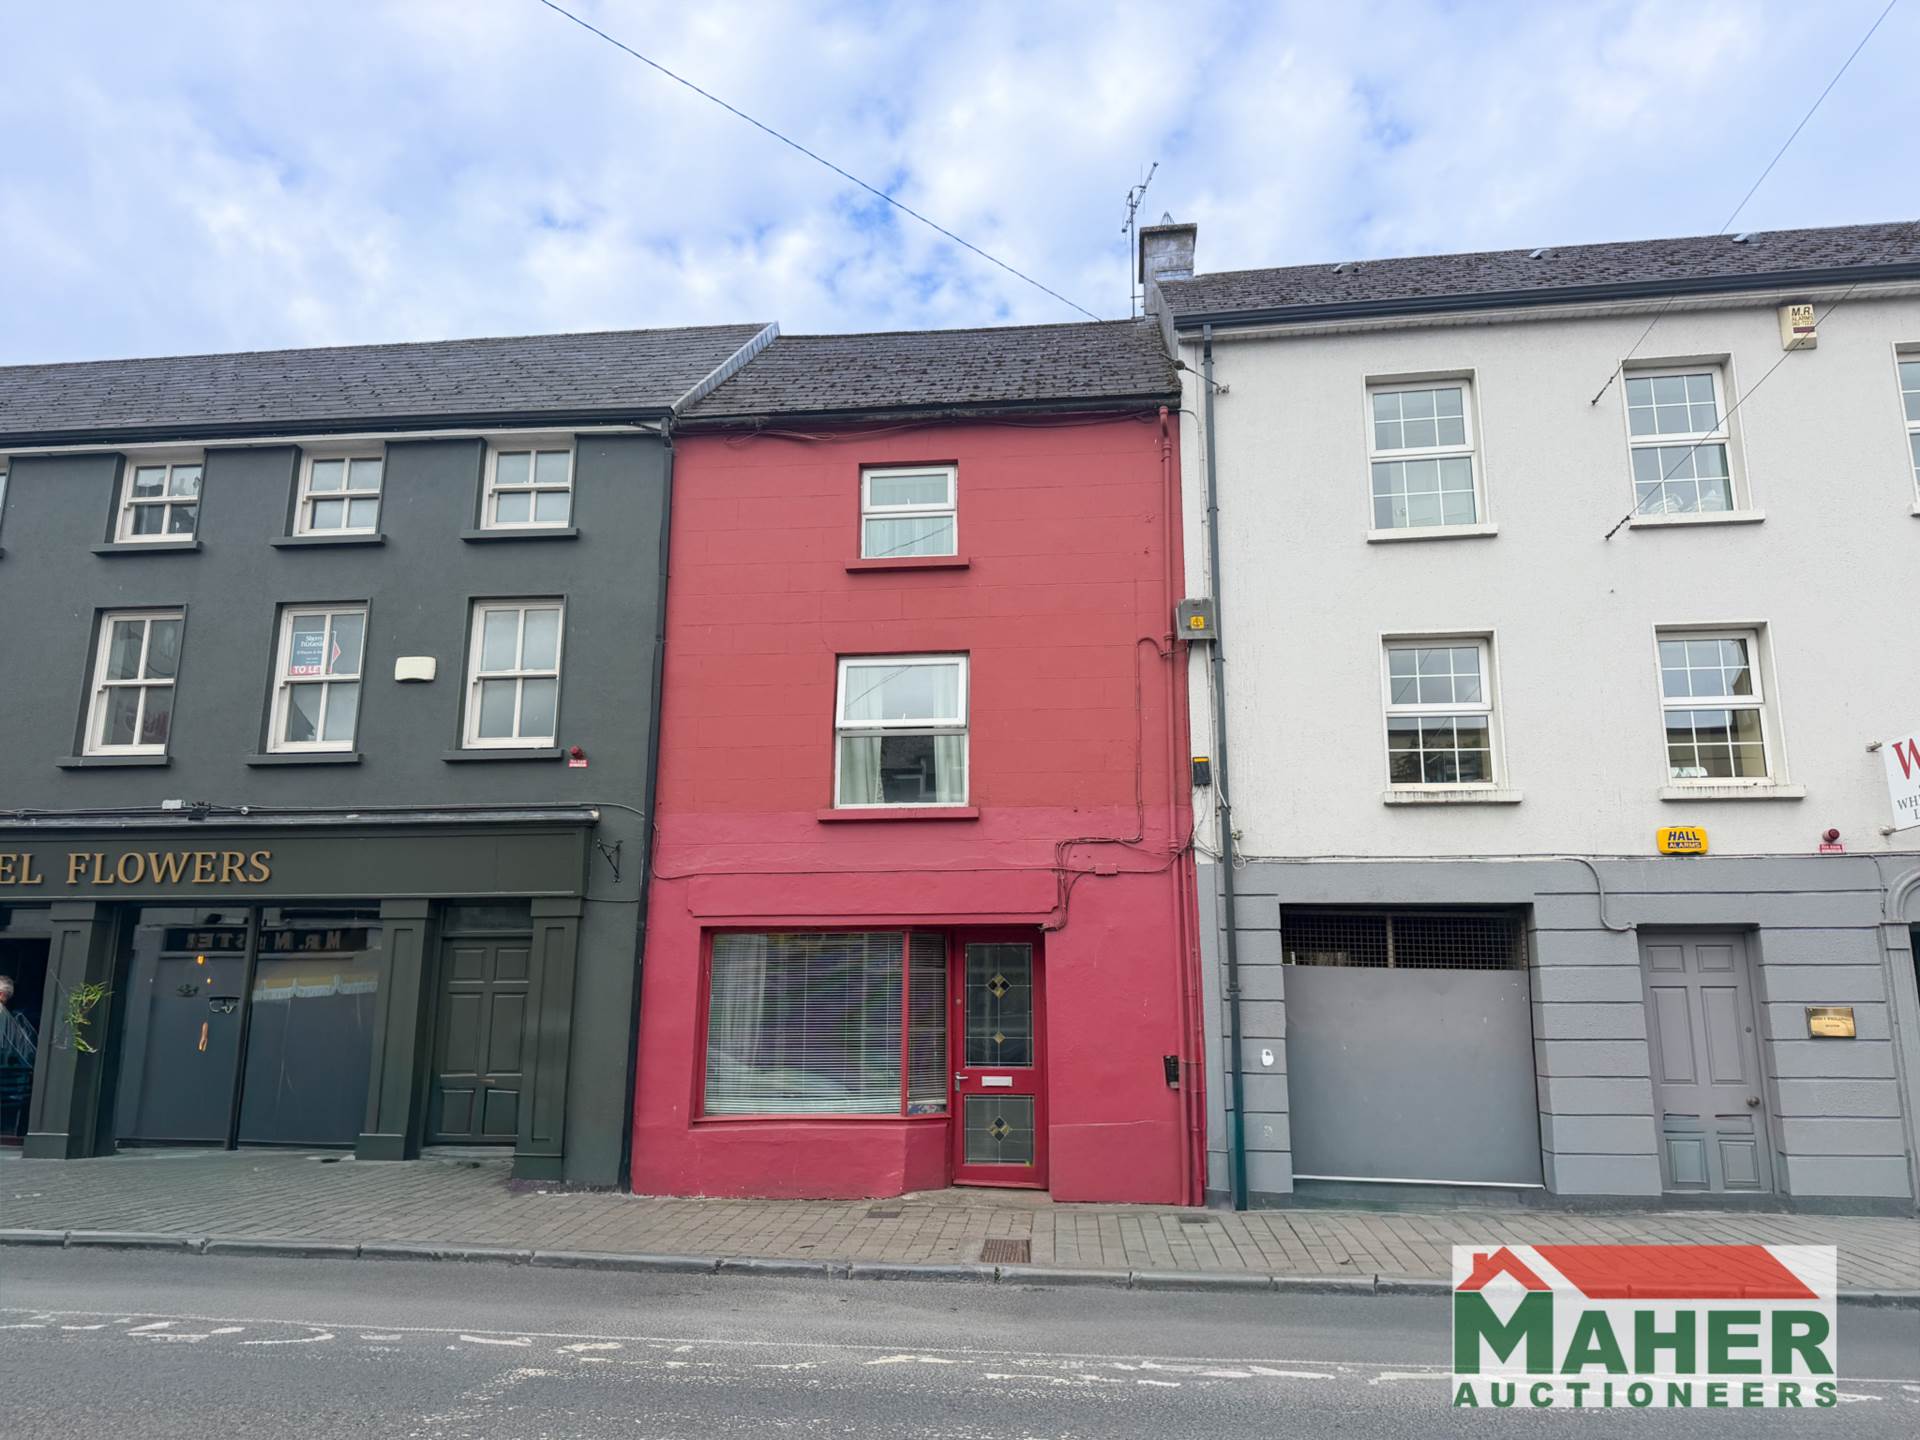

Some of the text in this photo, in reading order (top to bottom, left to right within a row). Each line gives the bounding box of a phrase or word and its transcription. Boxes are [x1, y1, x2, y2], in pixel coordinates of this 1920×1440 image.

[1897, 794, 1920, 810] WH
[1668, 831, 1701, 841] HALL
[66, 850, 273, 885] FLOWERS
